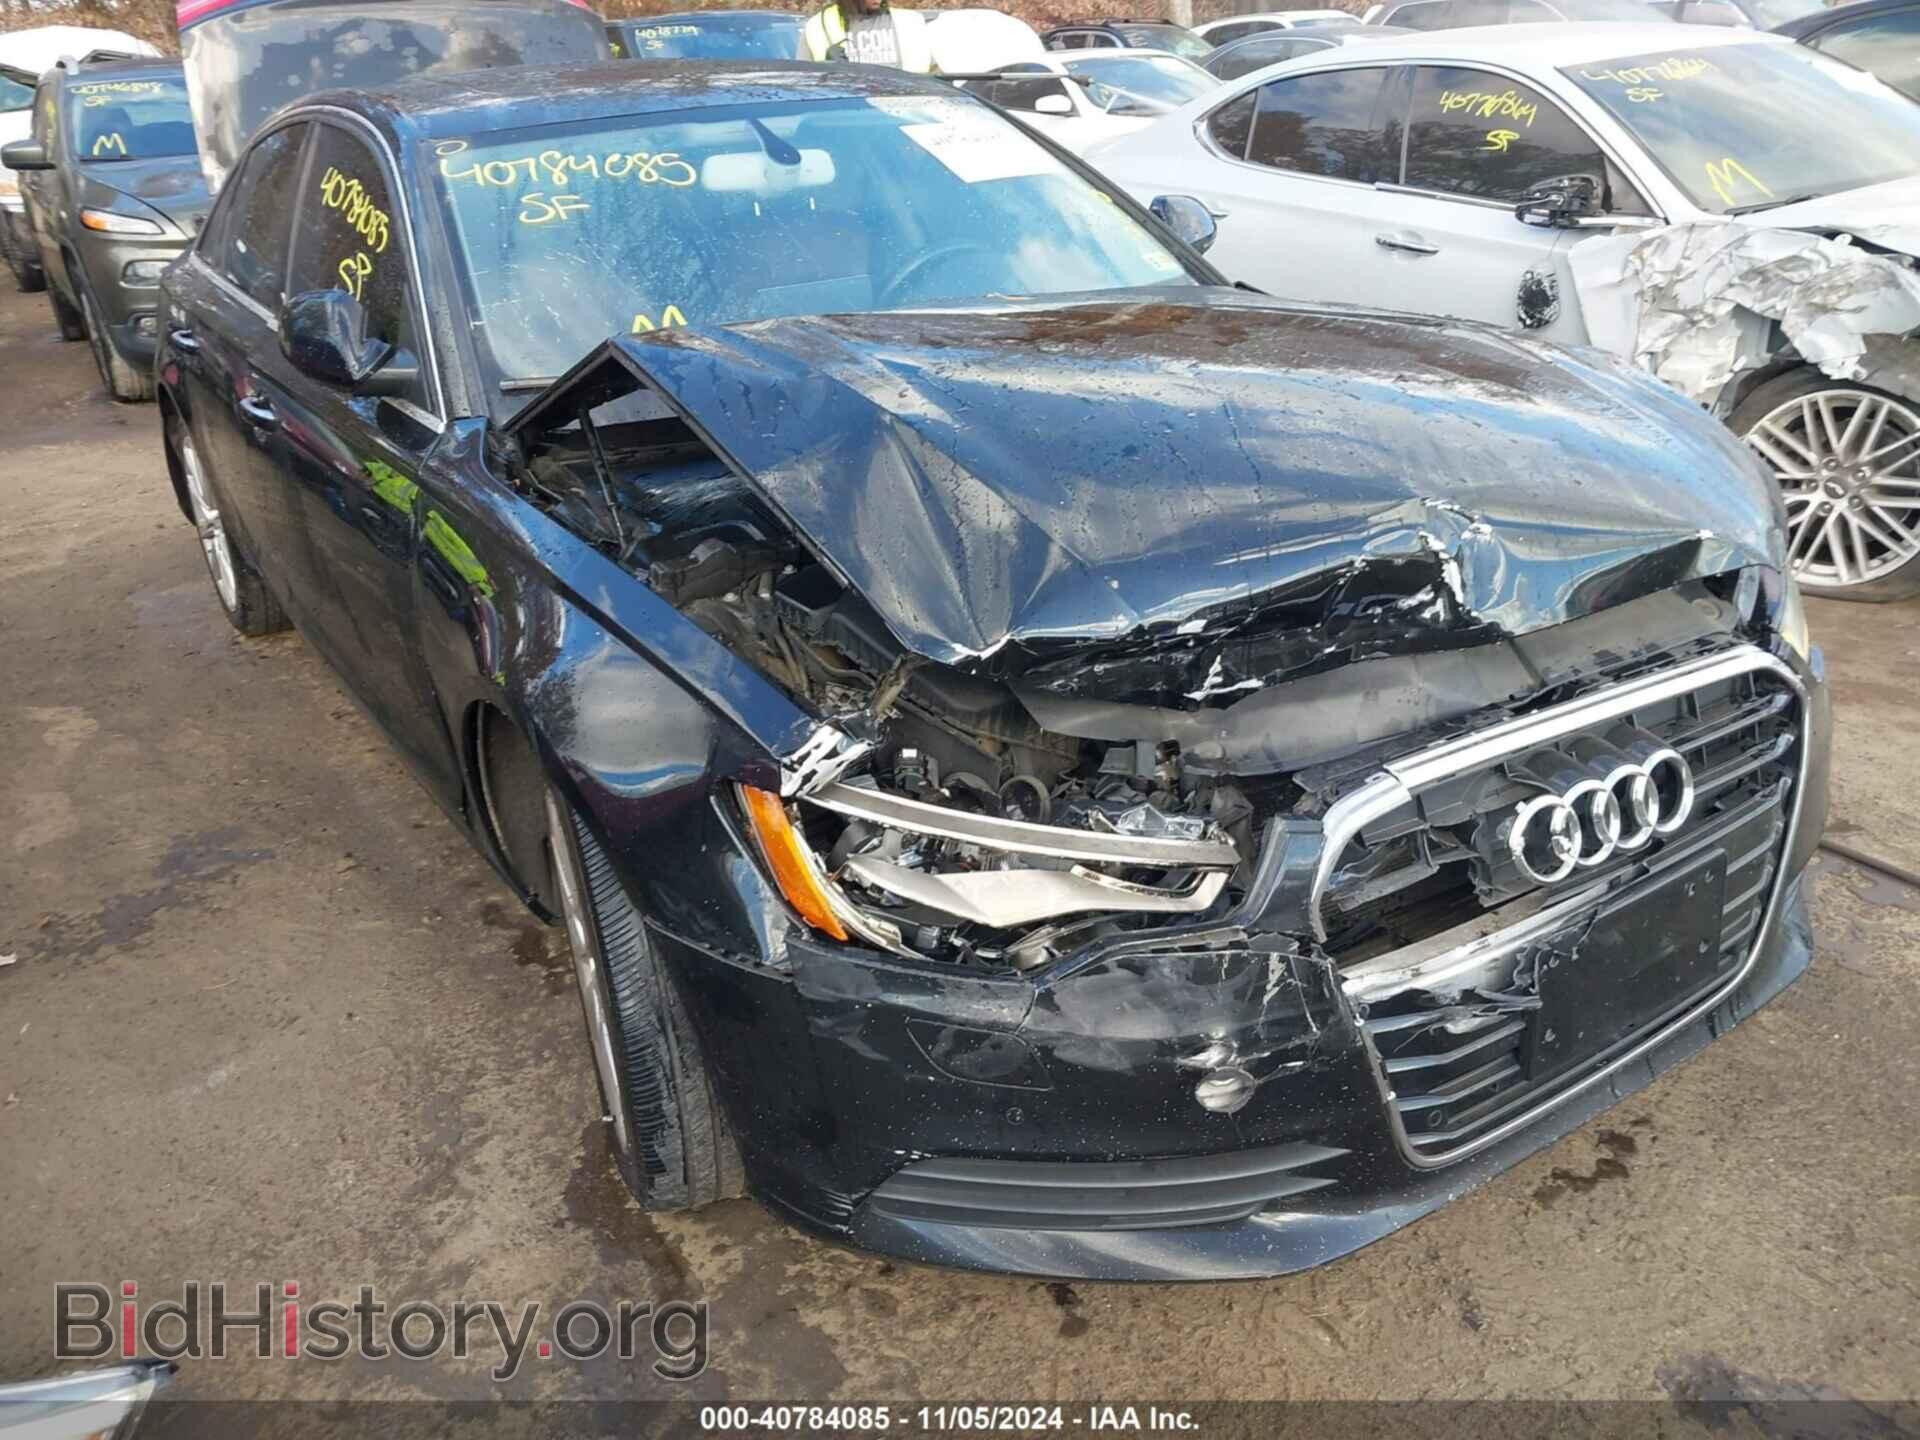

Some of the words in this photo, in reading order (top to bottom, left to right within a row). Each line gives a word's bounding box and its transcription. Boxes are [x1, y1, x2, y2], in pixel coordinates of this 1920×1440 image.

[92, 132, 127, 156] M
[439, 150, 697, 186] 40784085
[1704, 158, 1775, 206] M
[518, 192, 592, 224] SF
